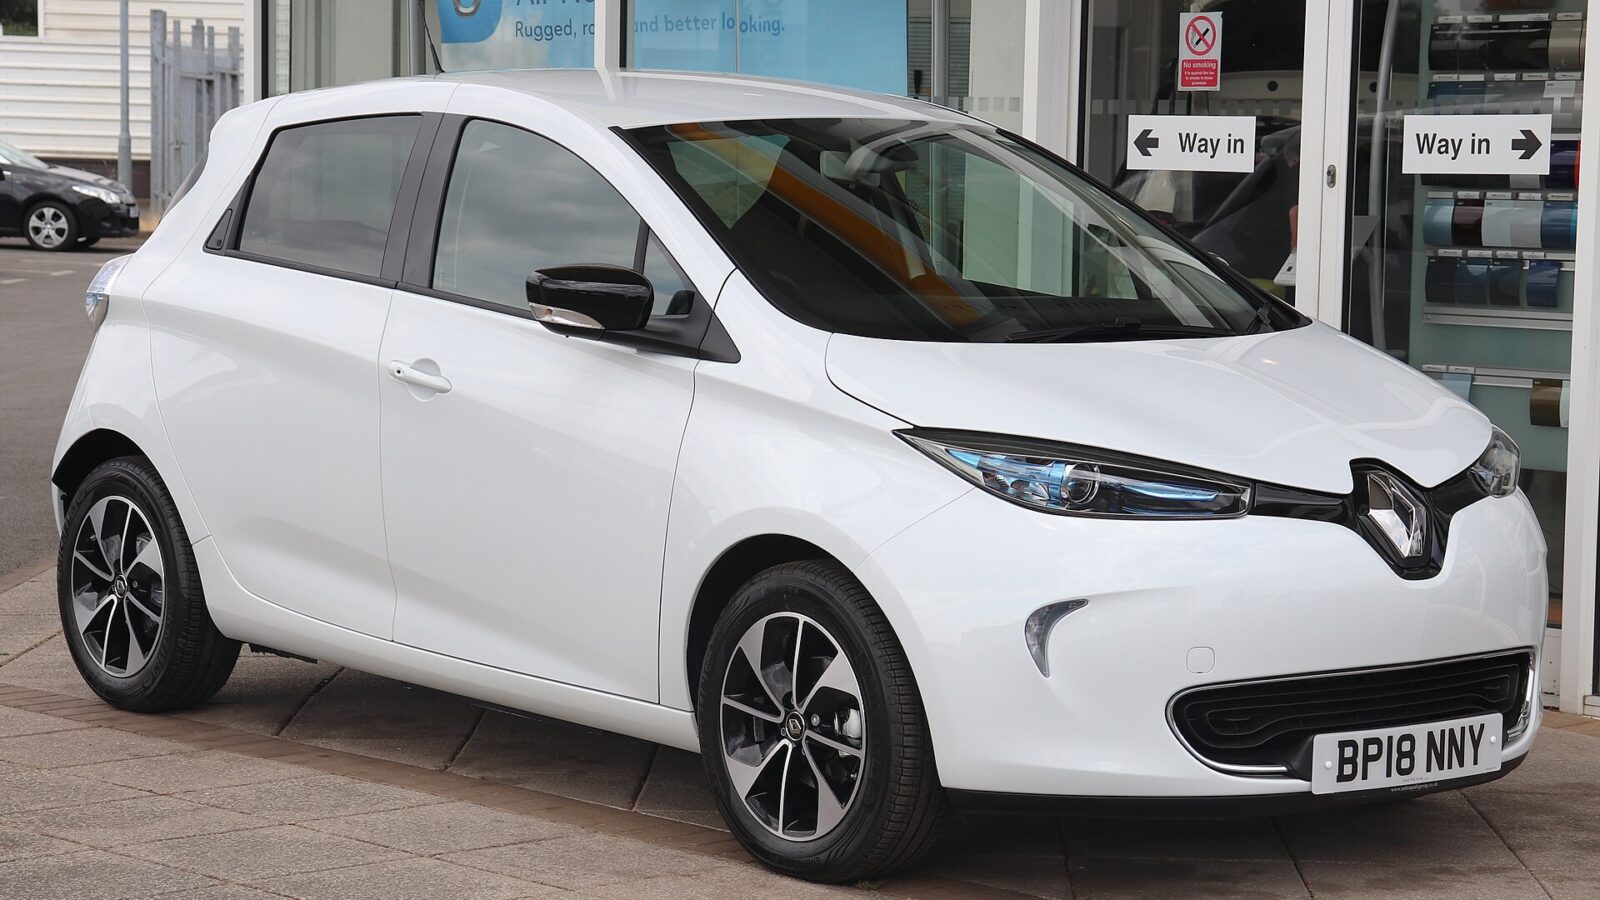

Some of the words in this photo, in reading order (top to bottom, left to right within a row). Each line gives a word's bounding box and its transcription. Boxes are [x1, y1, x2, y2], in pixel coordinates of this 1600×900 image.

[515, 19, 577, 41] Rugged,
[664, 14, 717, 32] better
[722, 12, 785, 36] looking.
[1192, 61, 1216, 69] smoking
[1178, 132, 1220, 159] Way
[1227, 133, 1244, 154] in
[1415, 133, 1463, 160] Way
[1470, 133, 1490, 154] in
[1336, 733, 1416, 783] BP18
[1426, 723, 1485, 773] NNY
